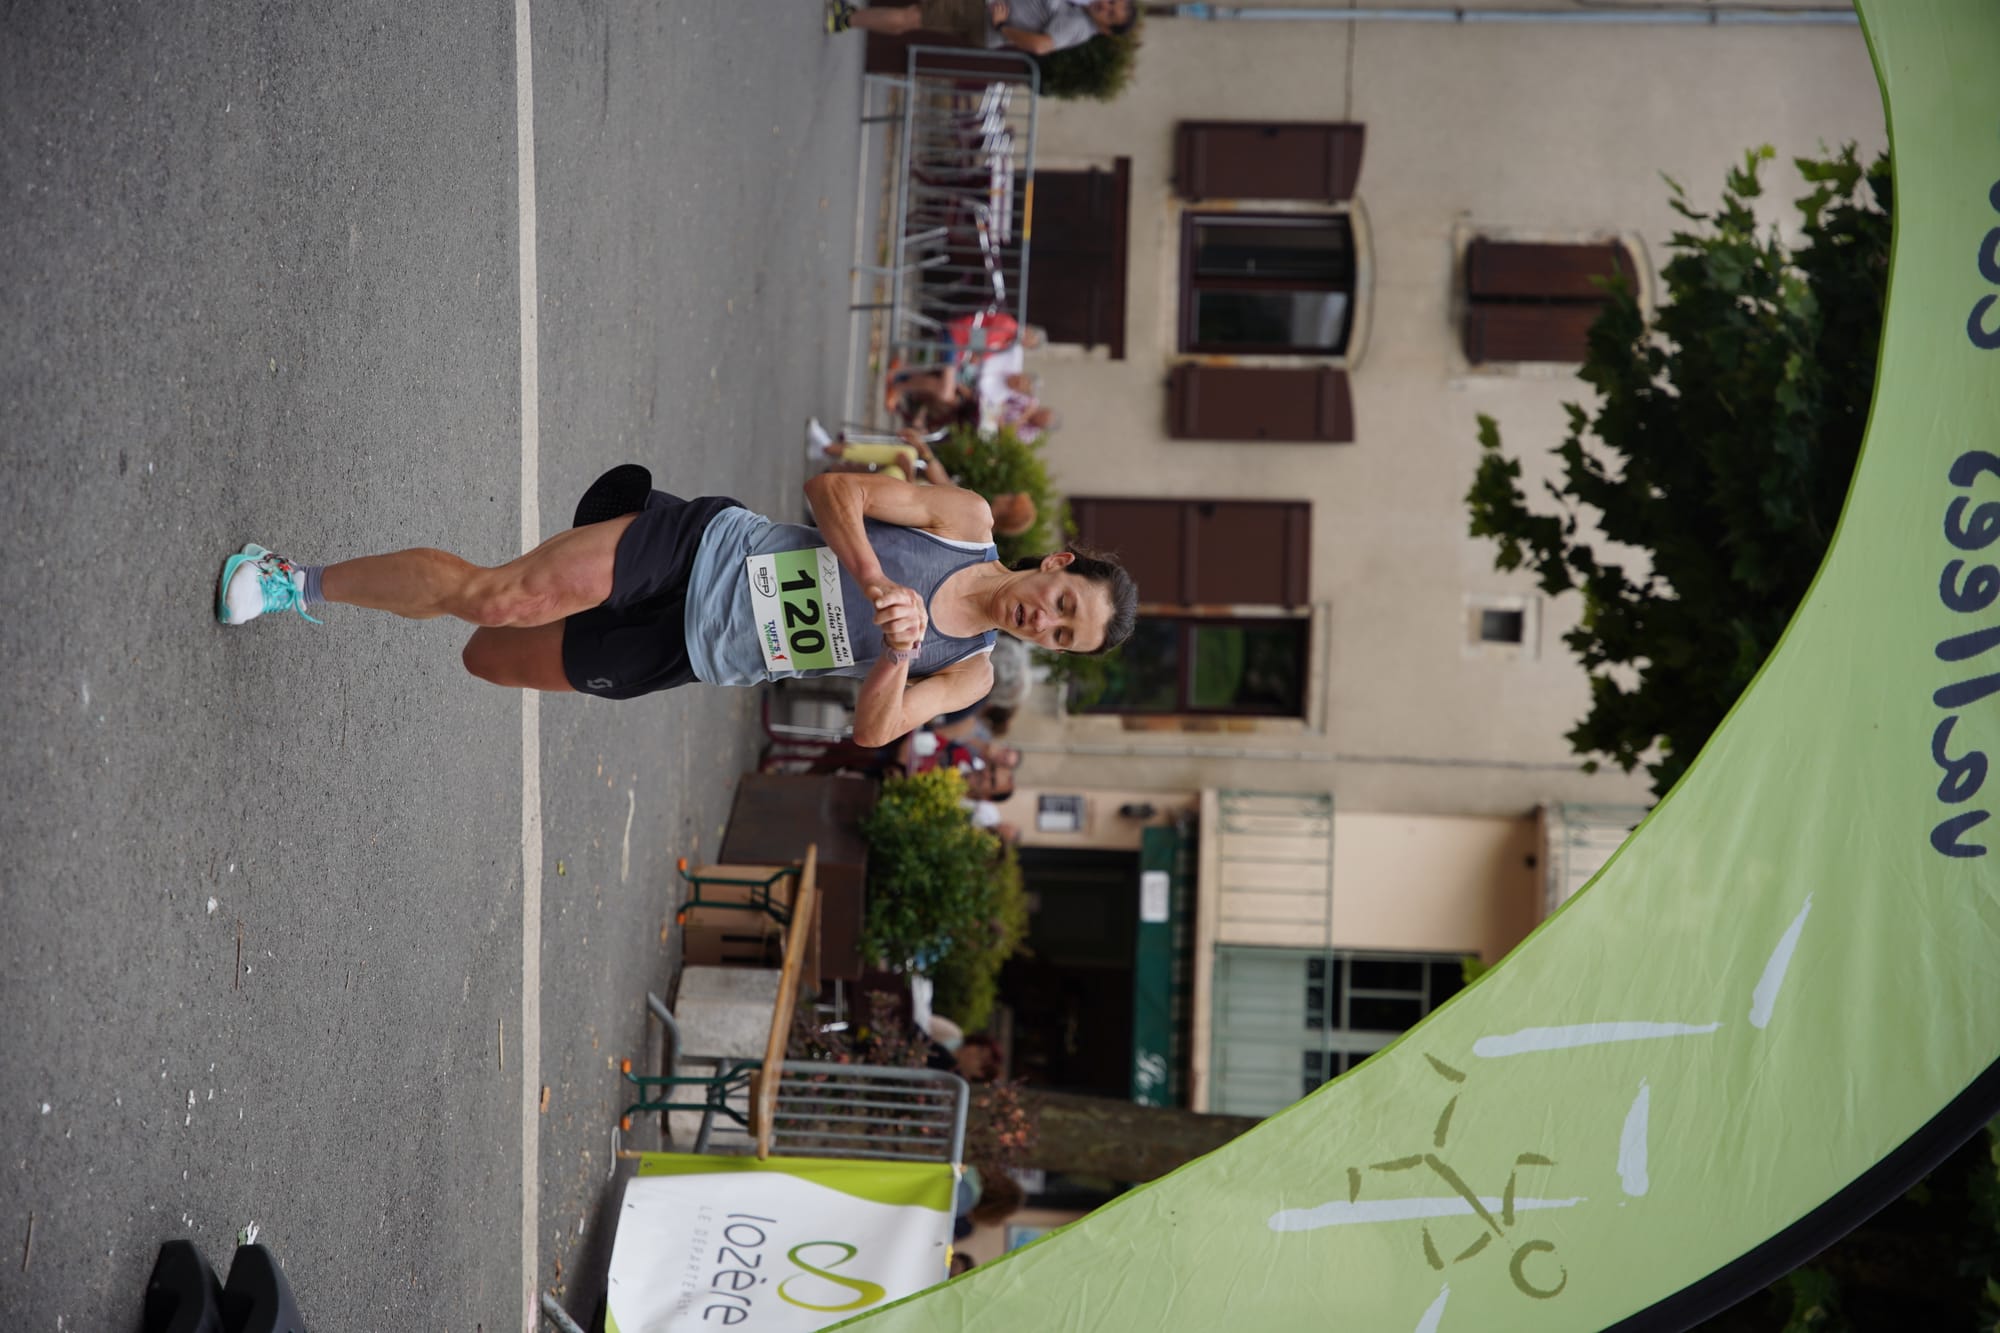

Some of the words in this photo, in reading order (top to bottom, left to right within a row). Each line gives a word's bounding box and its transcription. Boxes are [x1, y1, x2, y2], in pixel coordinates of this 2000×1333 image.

[759, 566, 770, 594] BFP
[781, 569, 825, 654] 120
[834, 606, 846, 643] Challenge
[767, 620, 781, 652] TUFF'S
[698, 1205, 712, 1222] LE
[702, 1213, 777, 1325] lozère
